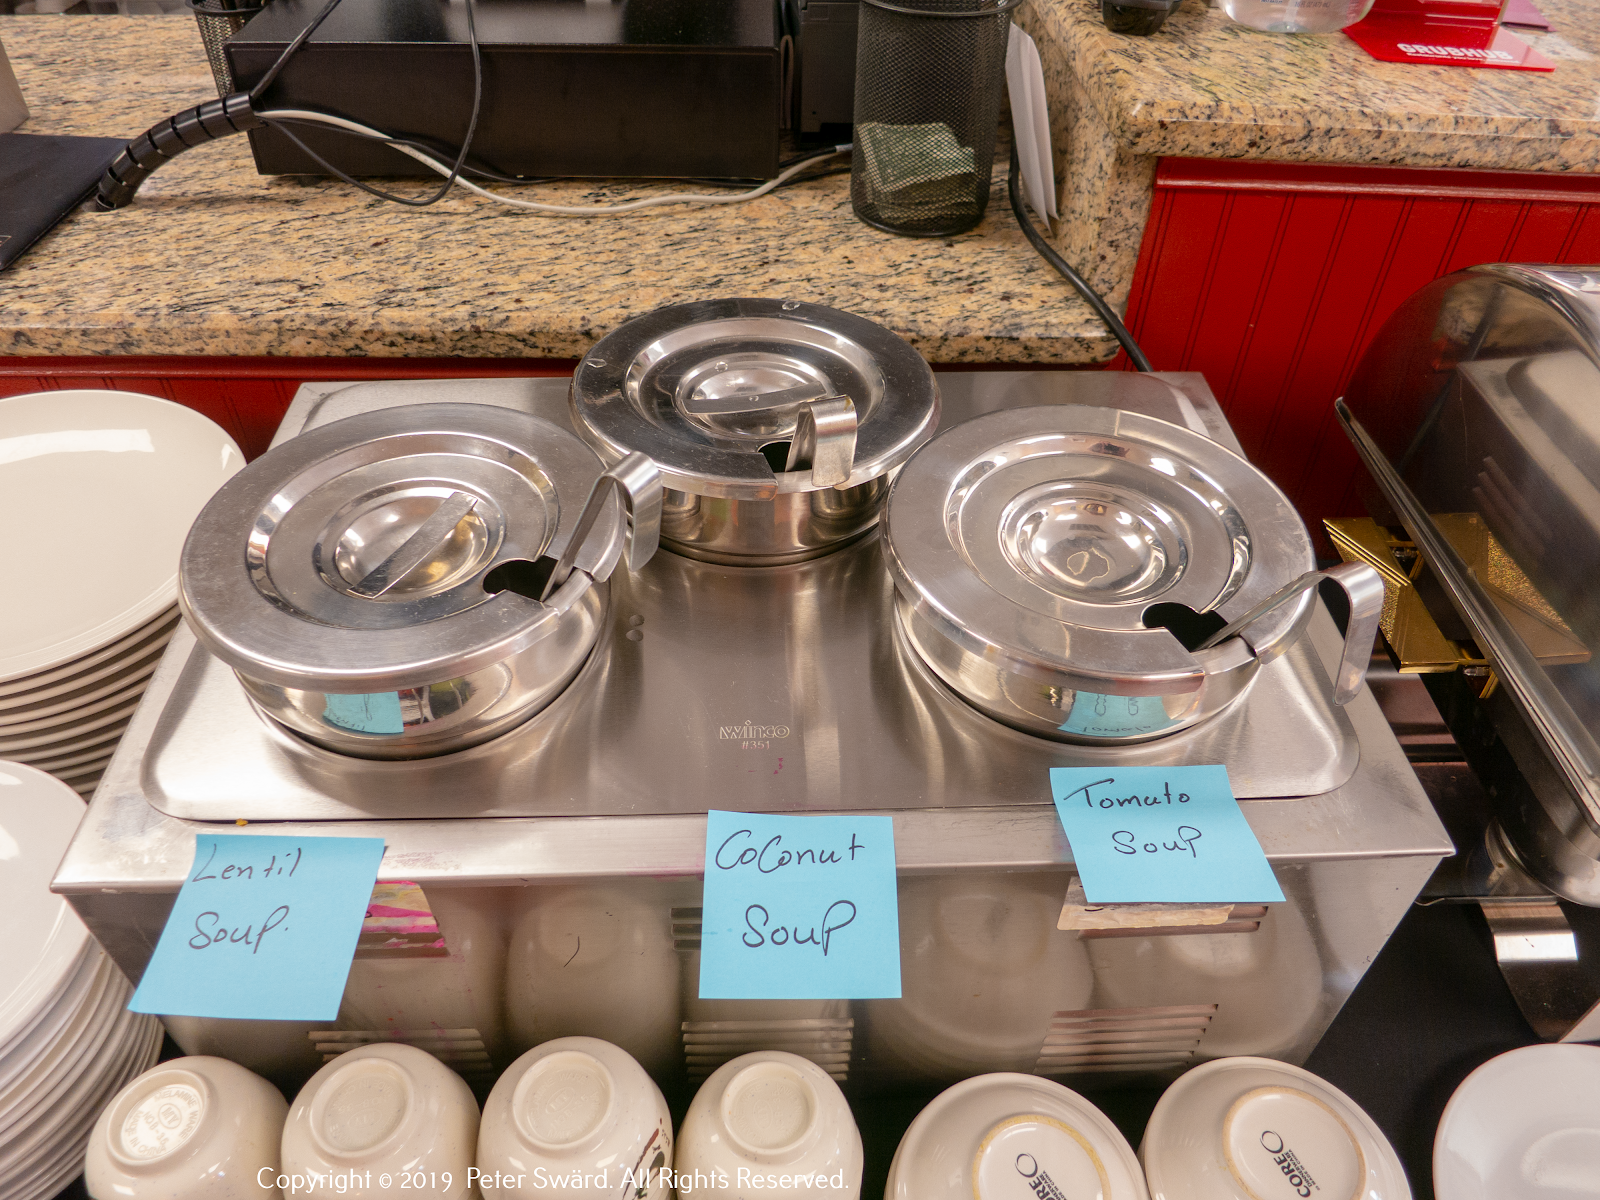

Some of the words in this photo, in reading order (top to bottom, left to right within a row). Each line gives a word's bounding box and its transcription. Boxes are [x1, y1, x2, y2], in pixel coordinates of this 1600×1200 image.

[1396, 43, 1513, 60] GRUBHUB
[741, 740, 770, 750] #351
[1063, 777, 1191, 809] Tomato
[192, 843, 302, 883] Lentil
[1273, 1153, 1311, 1198] CORE
[1284, 1151, 1313, 1188] DINNERWARE
